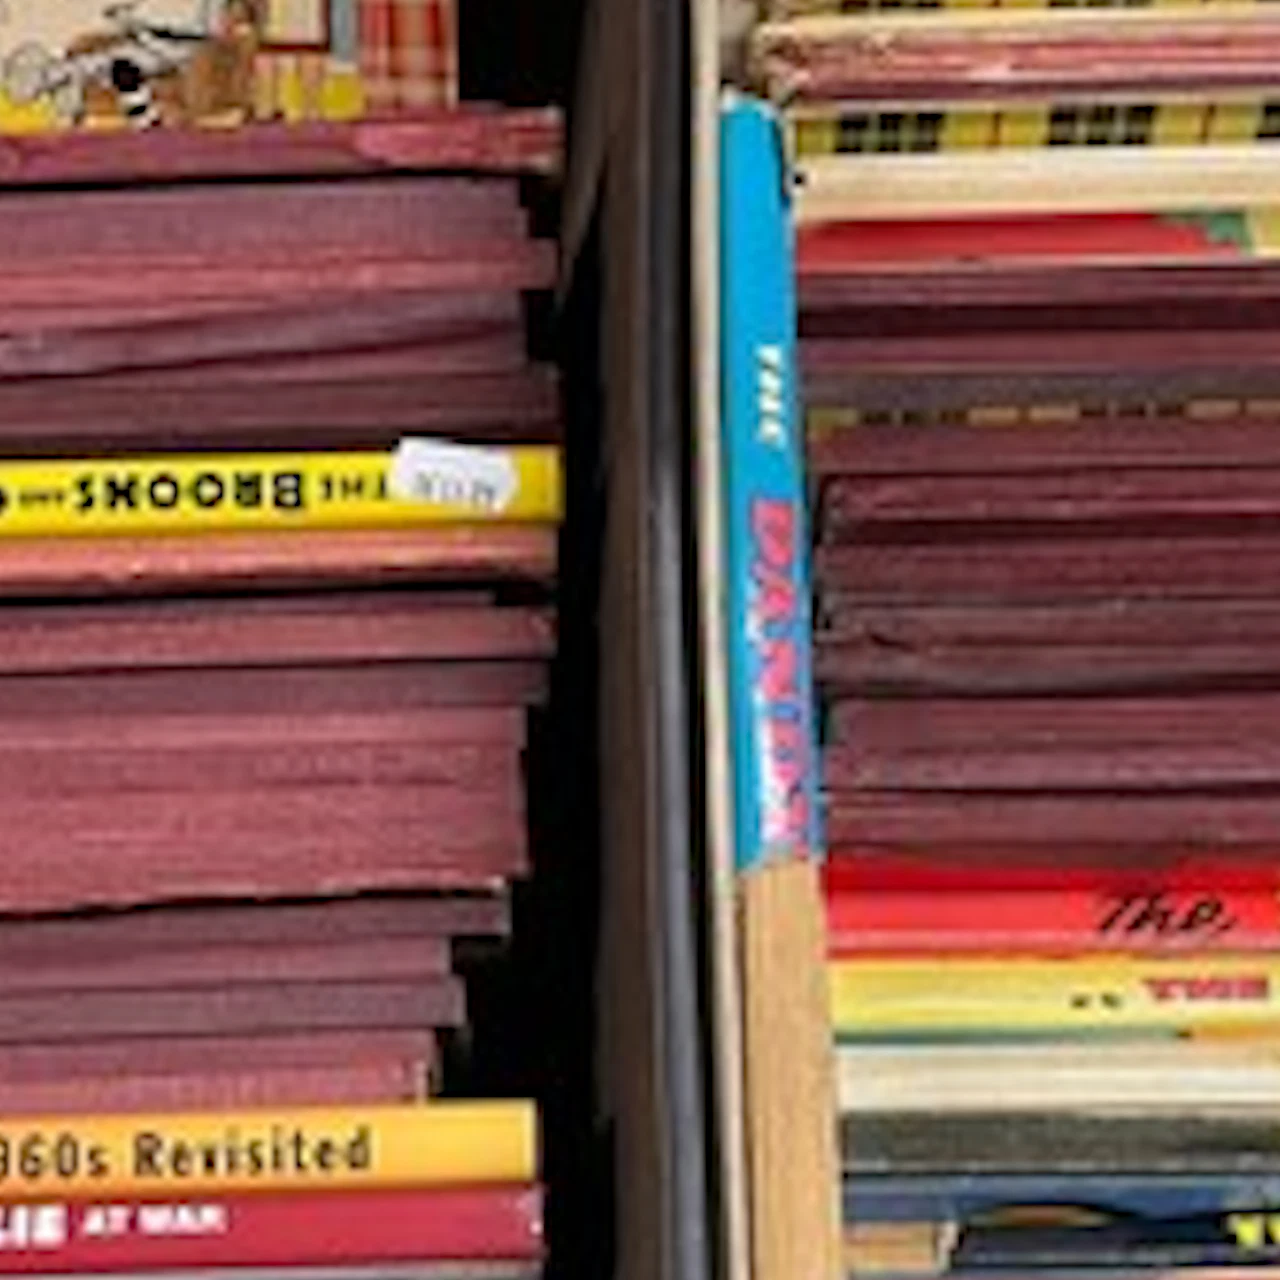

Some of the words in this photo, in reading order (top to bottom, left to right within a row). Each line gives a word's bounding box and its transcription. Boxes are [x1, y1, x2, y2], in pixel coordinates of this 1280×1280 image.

[74, 472, 305, 511] BROONS
[321, 474, 387, 503] THE
[1098, 892, 1239, 936] The
[133, 1125, 372, 1178] Revisited
[83, 1207, 132, 1236] AT
